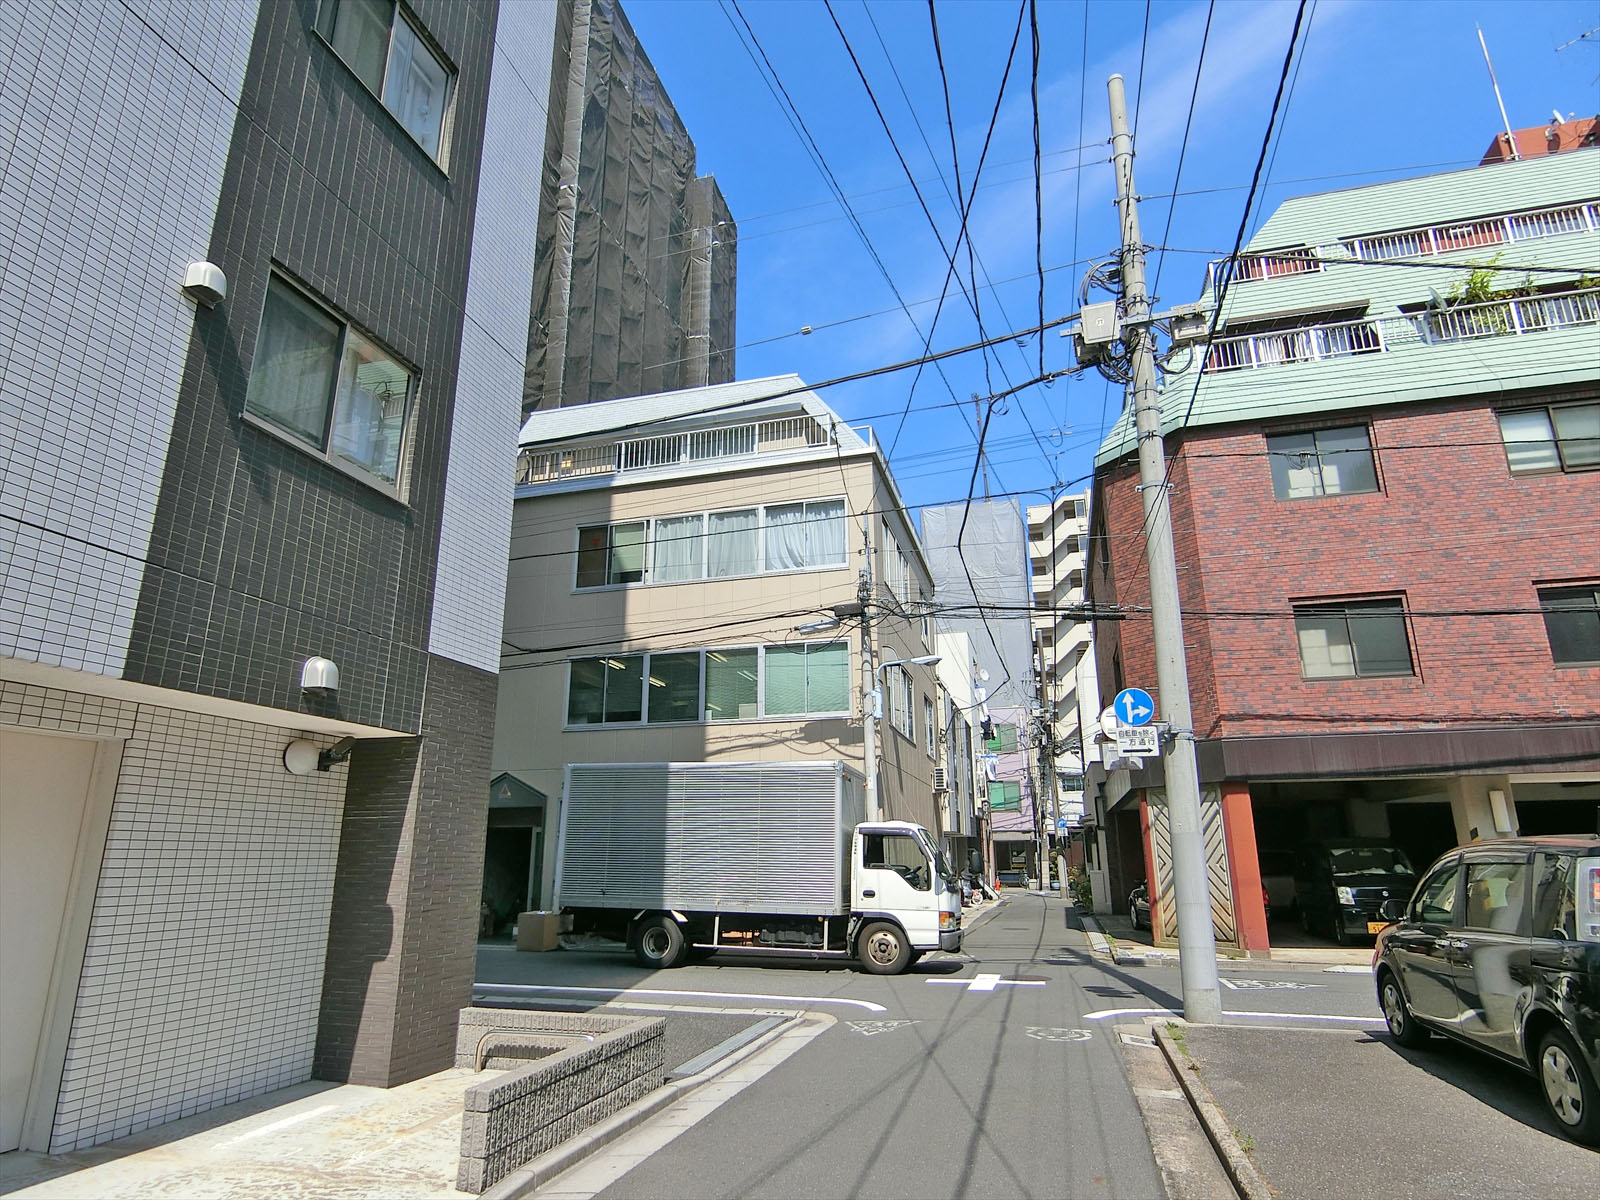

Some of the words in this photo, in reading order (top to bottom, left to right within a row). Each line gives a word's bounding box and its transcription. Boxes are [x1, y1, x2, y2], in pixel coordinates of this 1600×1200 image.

[1118, 729, 1154, 738] 自転車を除く
[1119, 738, 1155, 746] 一方通行
